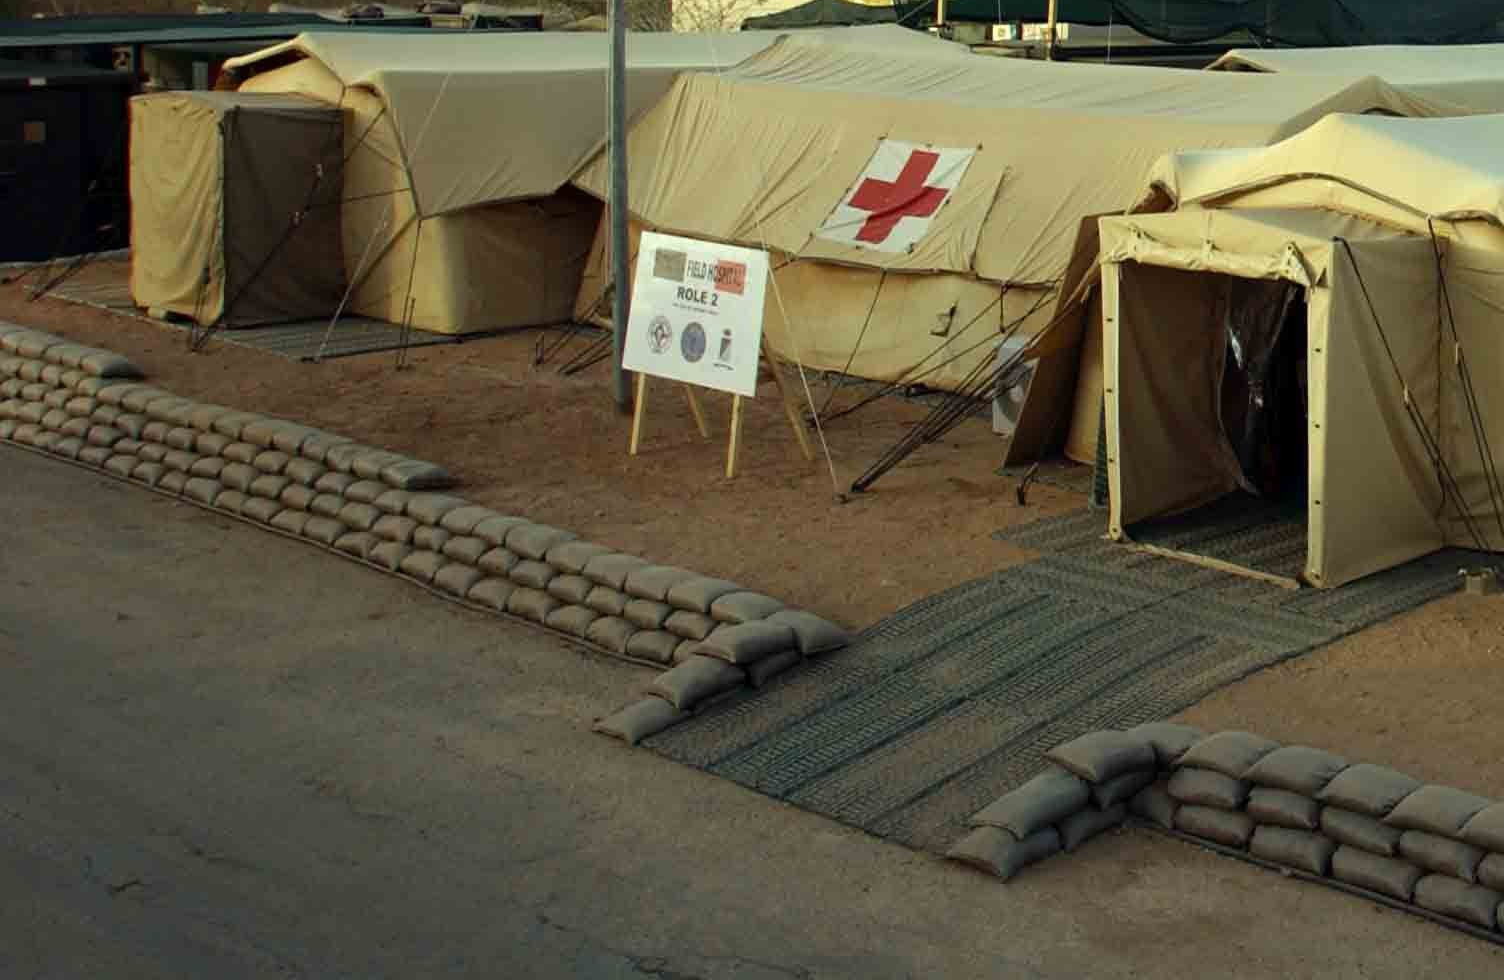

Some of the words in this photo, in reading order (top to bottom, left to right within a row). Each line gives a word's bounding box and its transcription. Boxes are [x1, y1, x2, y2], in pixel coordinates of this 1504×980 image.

[686, 260, 706, 280] FIELD
[677, 286, 707, 304] ROLE
[710, 293, 719, 306] 2
